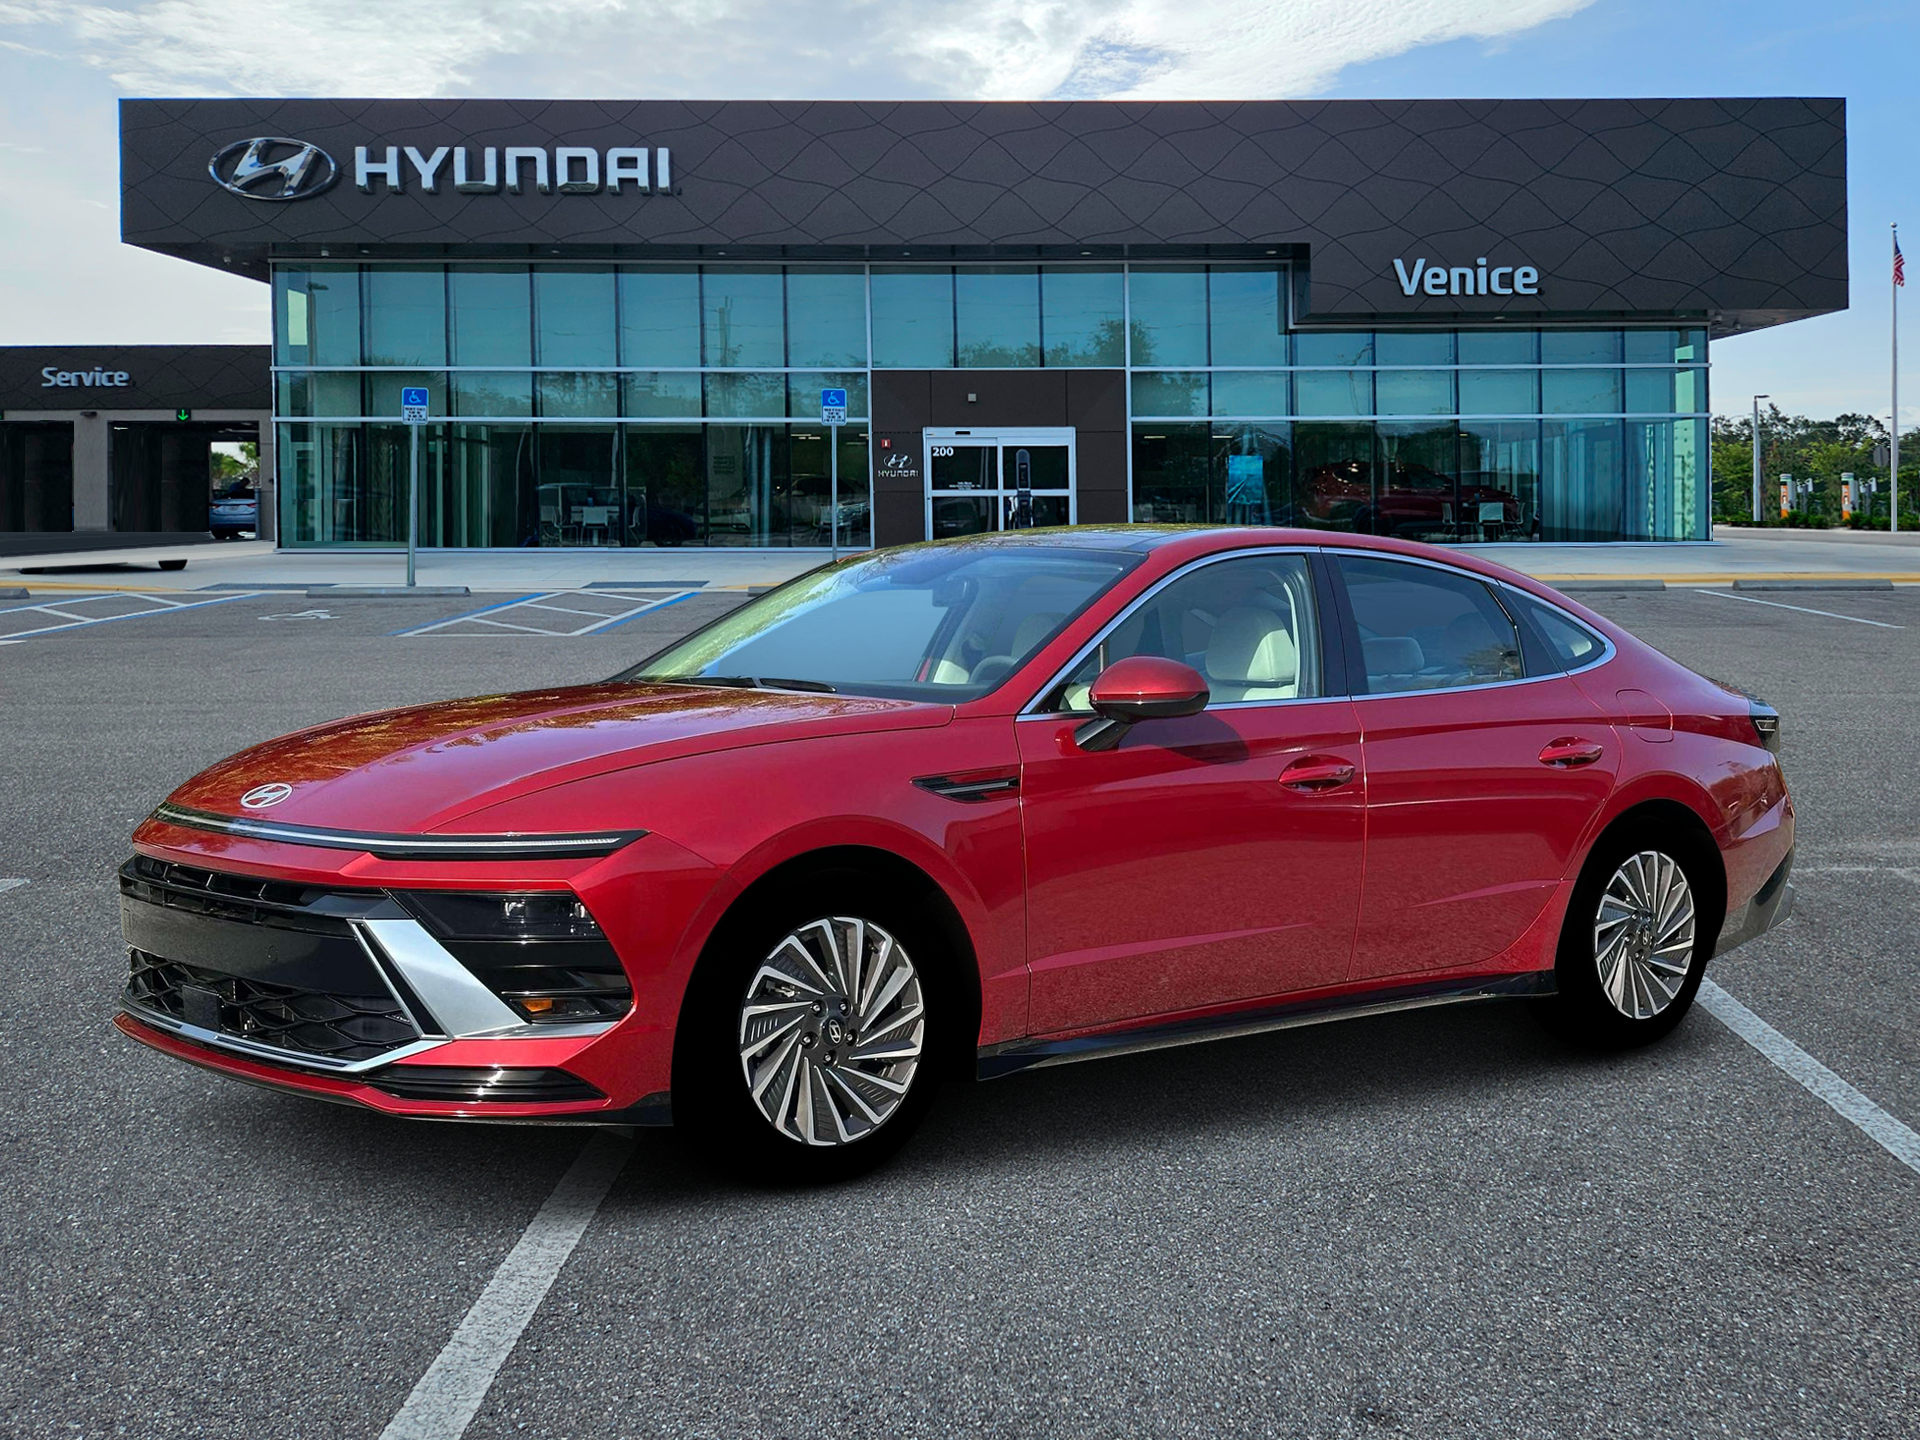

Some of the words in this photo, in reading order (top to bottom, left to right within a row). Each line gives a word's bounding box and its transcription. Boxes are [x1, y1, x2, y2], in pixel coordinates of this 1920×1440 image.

[355, 146, 671, 193] HYUNDAI
[1393, 257, 1539, 296] Venice
[41, 366, 130, 387] Service
[932, 446, 954, 457] 200
[877, 469, 919, 478] HYUNDAI
